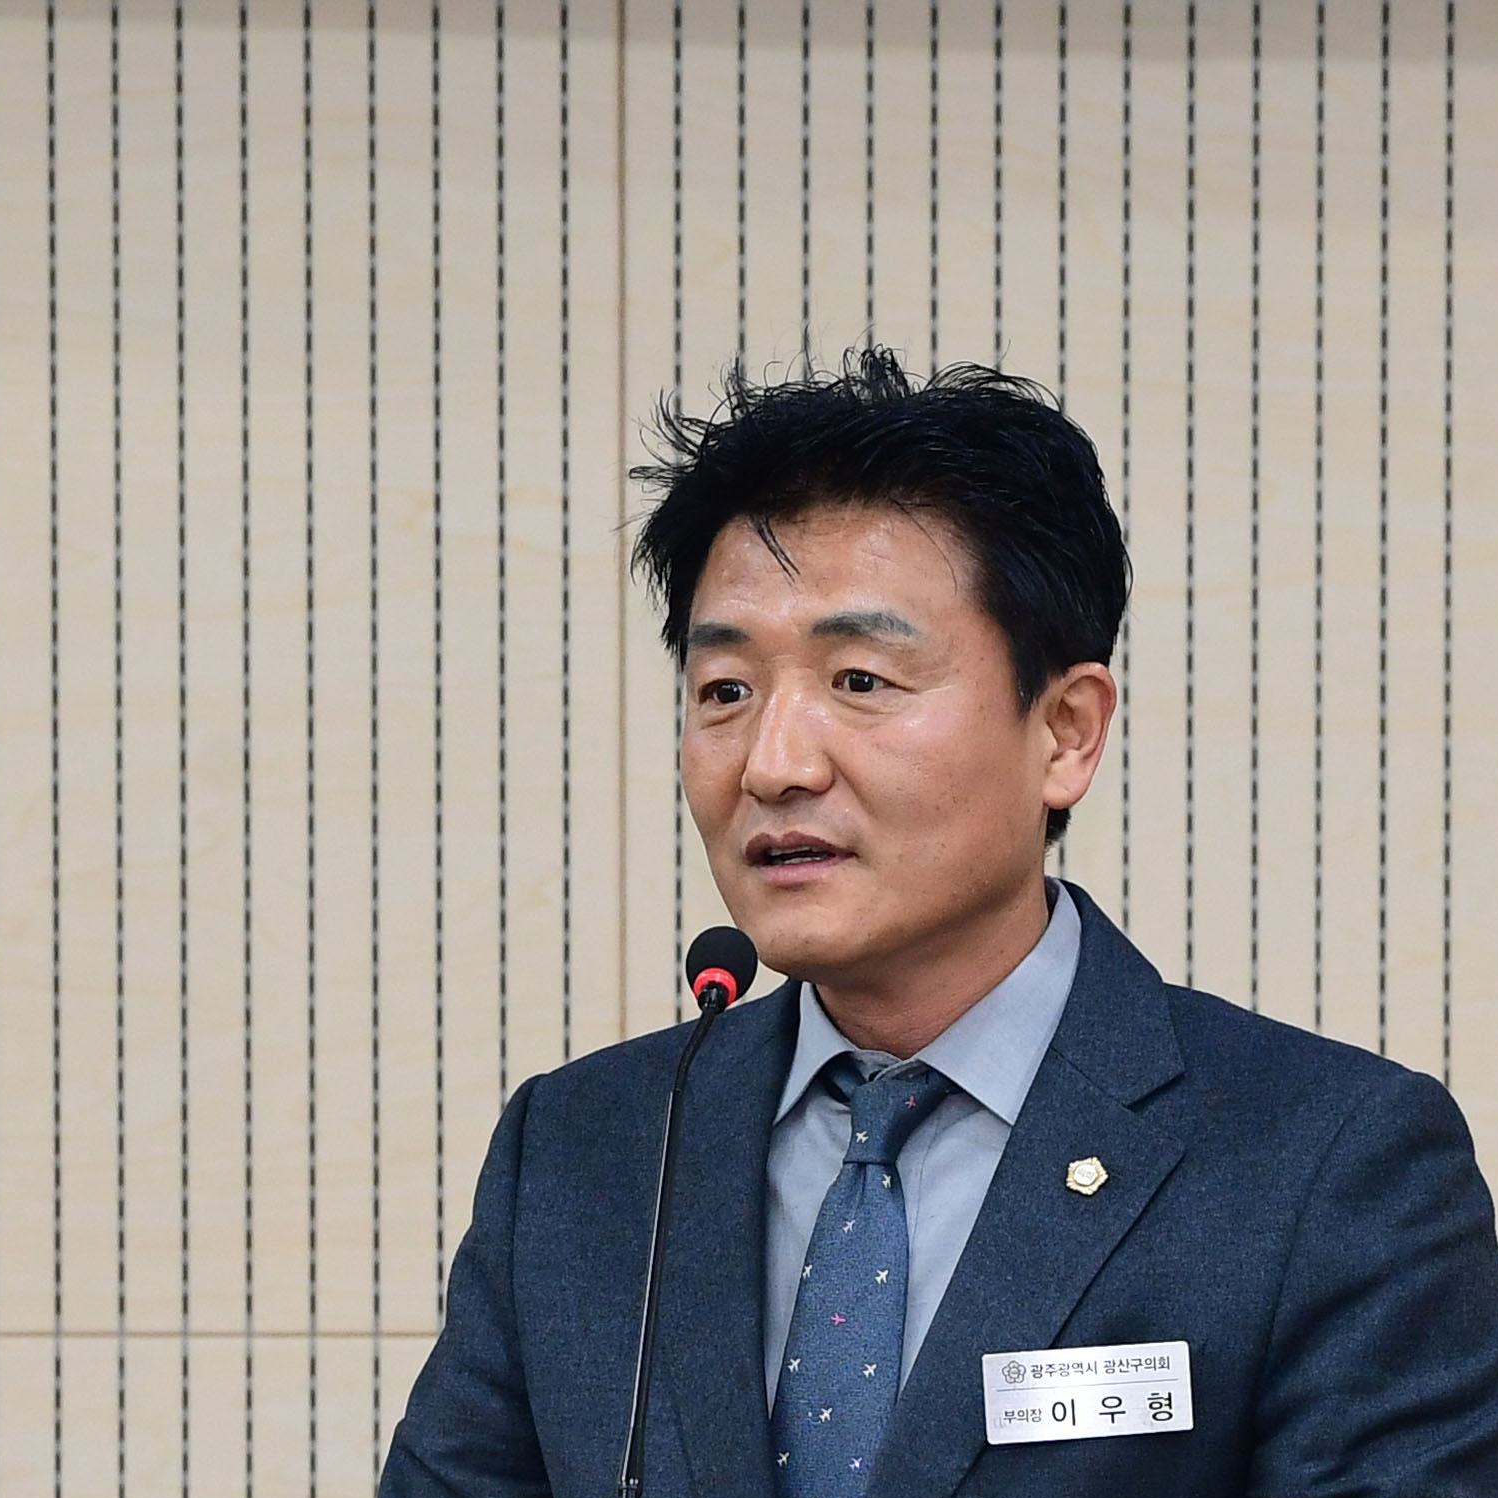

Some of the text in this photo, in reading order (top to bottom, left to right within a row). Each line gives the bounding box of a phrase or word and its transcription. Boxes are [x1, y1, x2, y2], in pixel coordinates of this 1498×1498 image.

[1030, 1356, 1171, 1379] 광주광역시 광산구의회
[1003, 1408, 1042, 1424] 부의장
